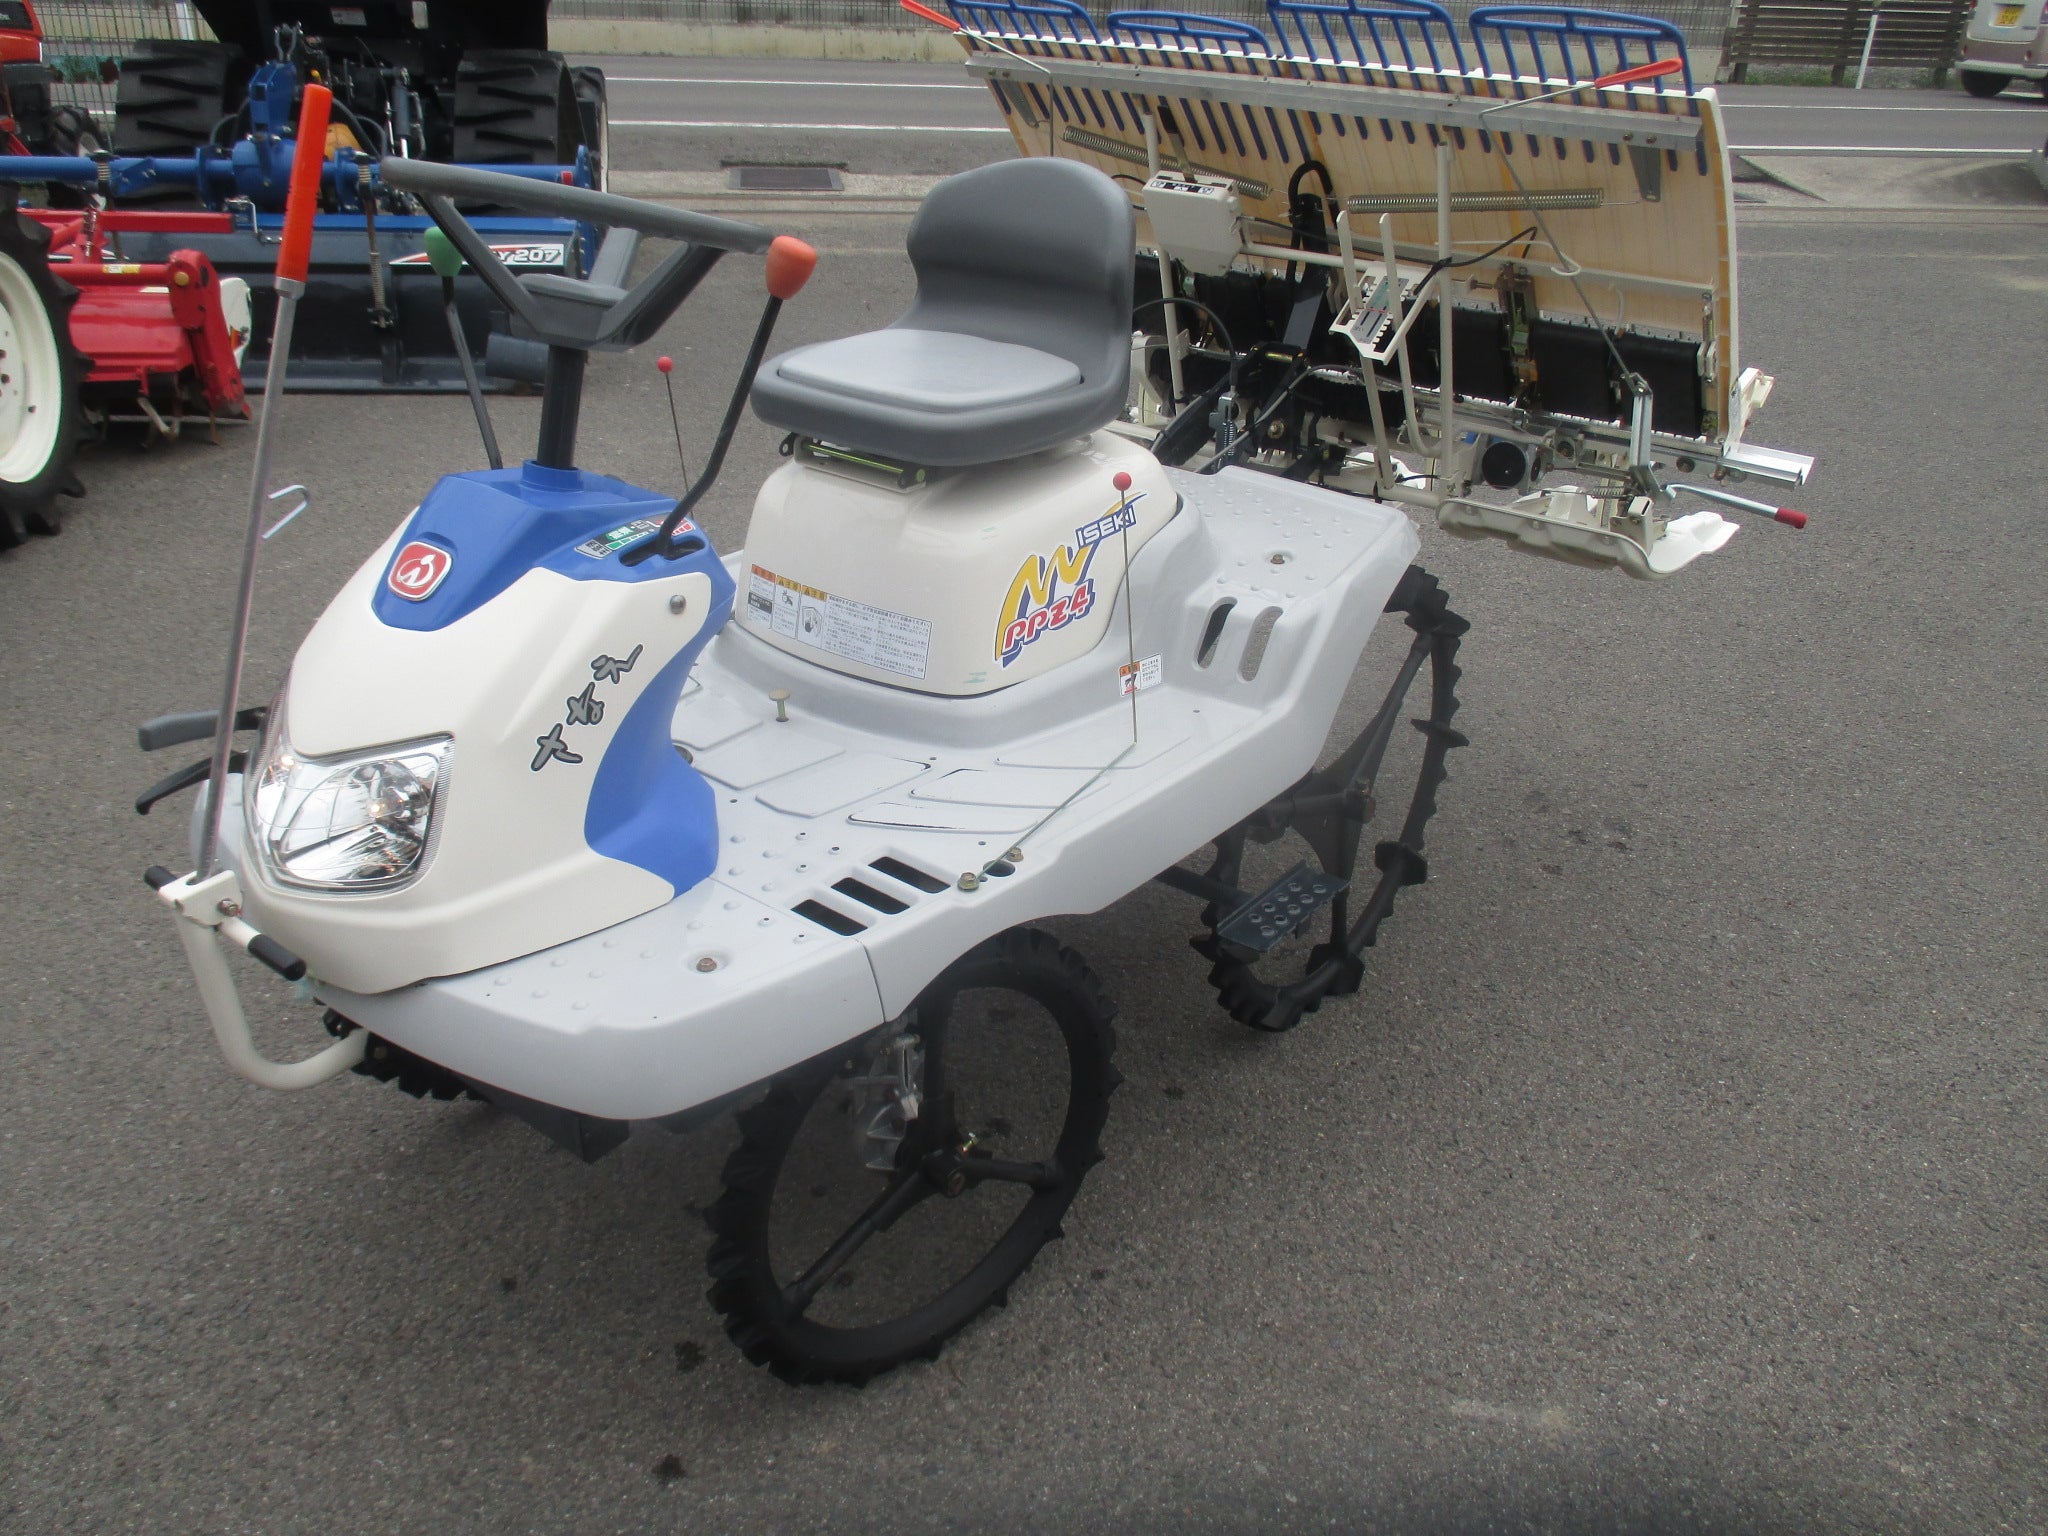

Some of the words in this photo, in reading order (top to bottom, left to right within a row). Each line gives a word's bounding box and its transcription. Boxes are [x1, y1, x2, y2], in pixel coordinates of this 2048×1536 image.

[513, 249, 561, 263] 207
[1076, 506, 1136, 547] ISEKI
[1003, 583, 1091, 651] PPZ4
